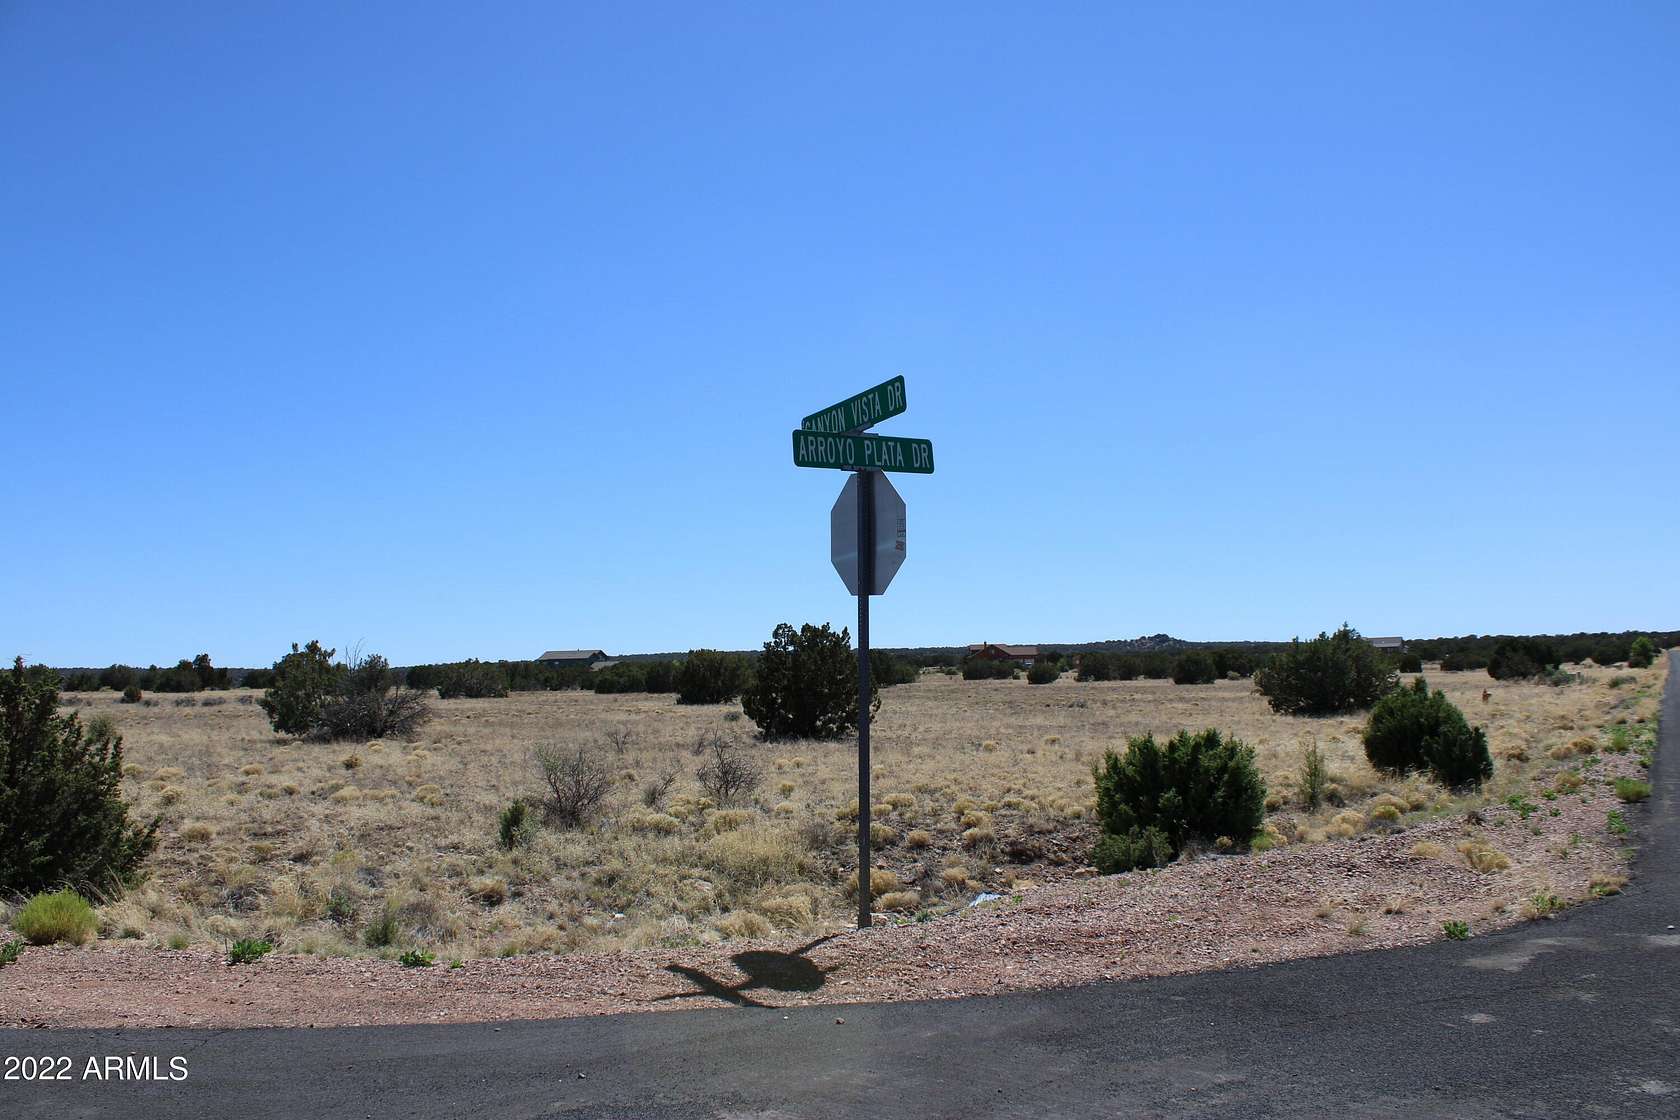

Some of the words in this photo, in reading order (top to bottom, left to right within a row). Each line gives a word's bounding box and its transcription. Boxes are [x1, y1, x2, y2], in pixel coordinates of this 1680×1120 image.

[851, 392, 882, 426] VISTA
[887, 382, 903, 411] DR
[799, 435, 855, 465] ARROYO
[864, 440, 905, 467] PLATA
[912, 443, 931, 468] DR
